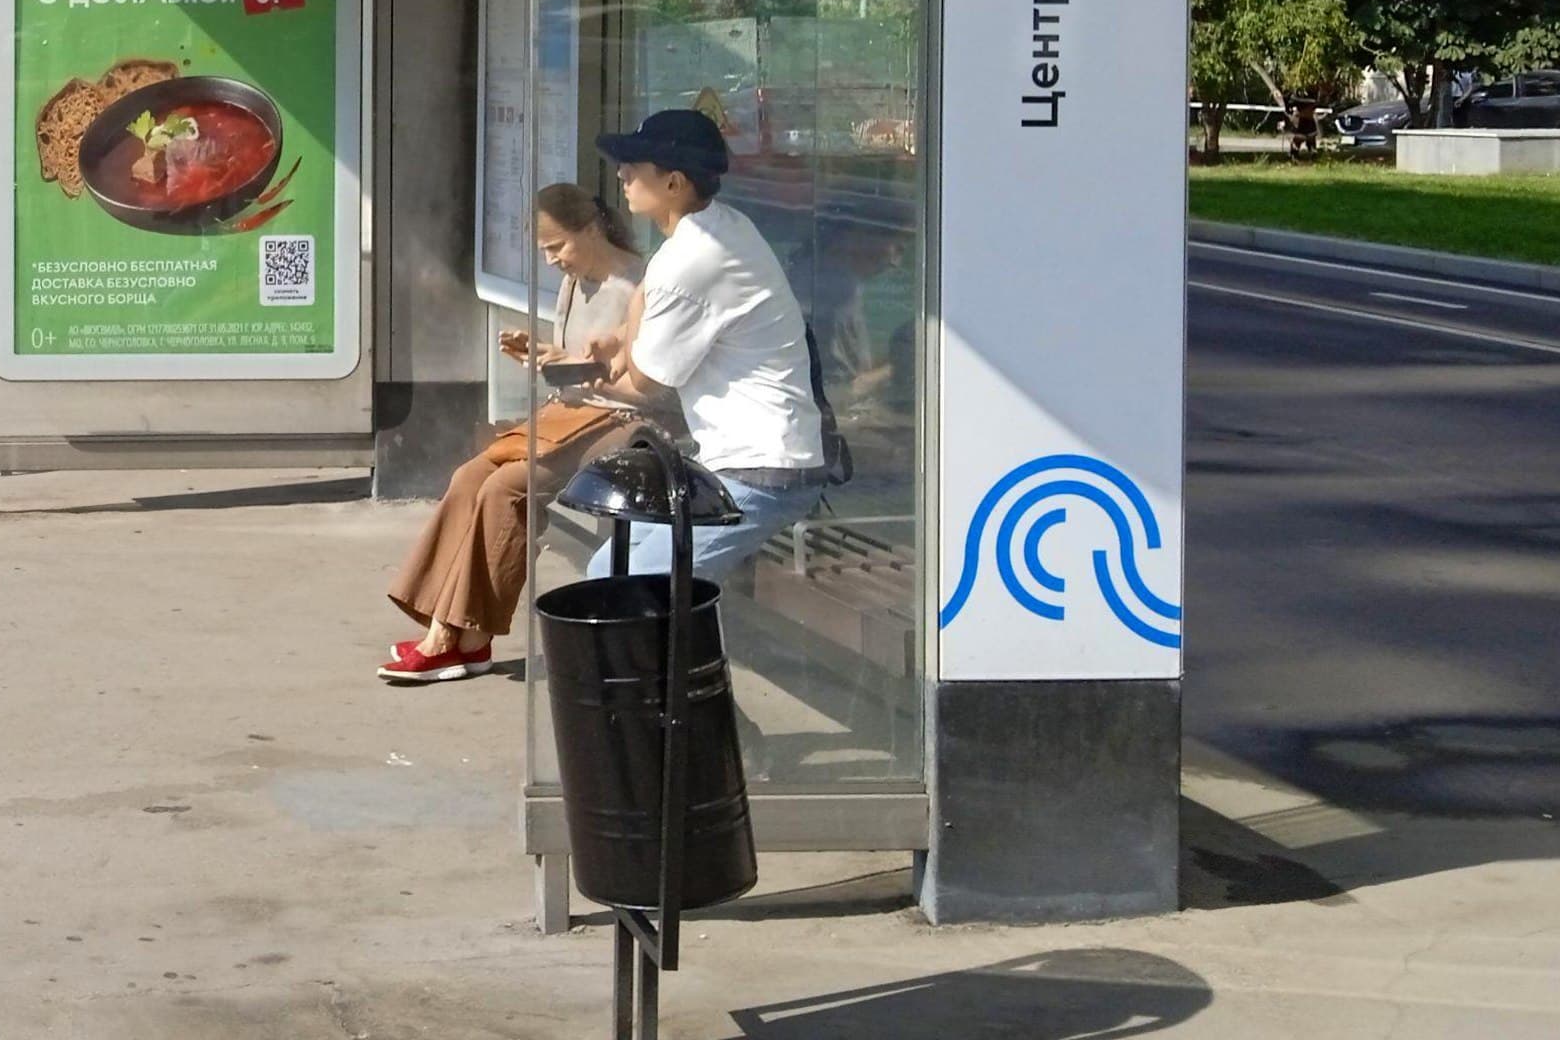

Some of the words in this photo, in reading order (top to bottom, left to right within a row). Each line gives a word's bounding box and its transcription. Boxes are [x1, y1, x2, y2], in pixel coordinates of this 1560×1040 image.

[130, 259, 218, 272] БЕСПЛАТНАЯ
[31, 277, 104, 290] ДОСТАВКА
[107, 276, 197, 288] БЕЗУСЛОВНО
[32, 293, 105, 306] ВКУСНОГО
[108, 292, 158, 305] БОРЩА
[31, 327, 57, 349] 0+
